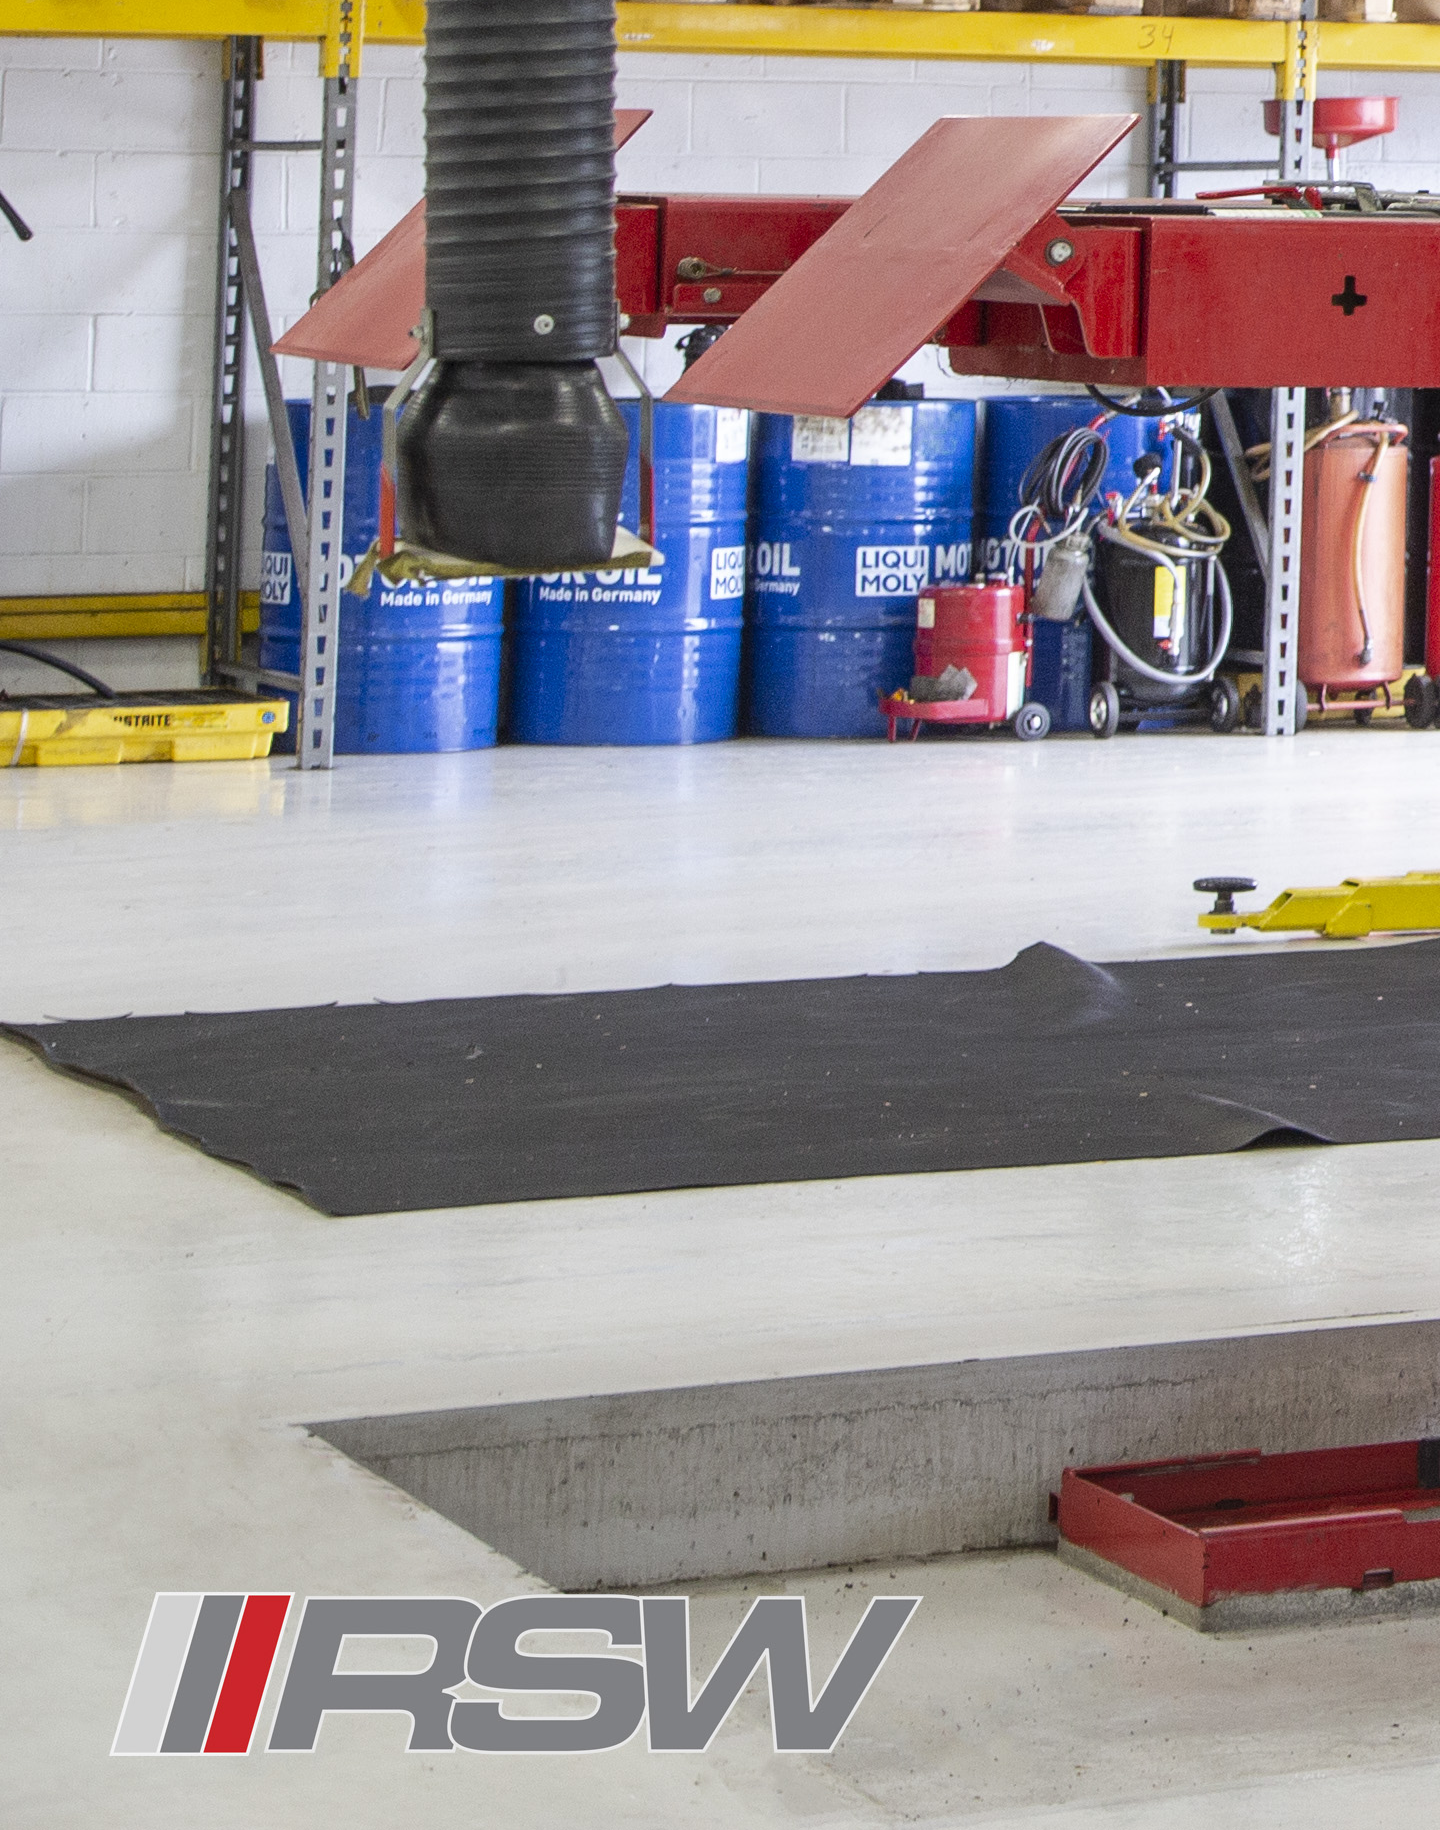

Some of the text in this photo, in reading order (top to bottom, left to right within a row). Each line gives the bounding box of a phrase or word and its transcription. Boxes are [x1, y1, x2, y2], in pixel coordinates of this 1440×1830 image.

[1138, 24, 1175, 54] 34
[262, 556, 288, 576] QUI
[756, 542, 801, 577] OIL
[861, 550, 925, 569] LIQUI
[861, 573, 927, 593] MOLY
[380, 589, 493, 607] Made in Germany
[539, 586, 663, 606] Made in Germany
